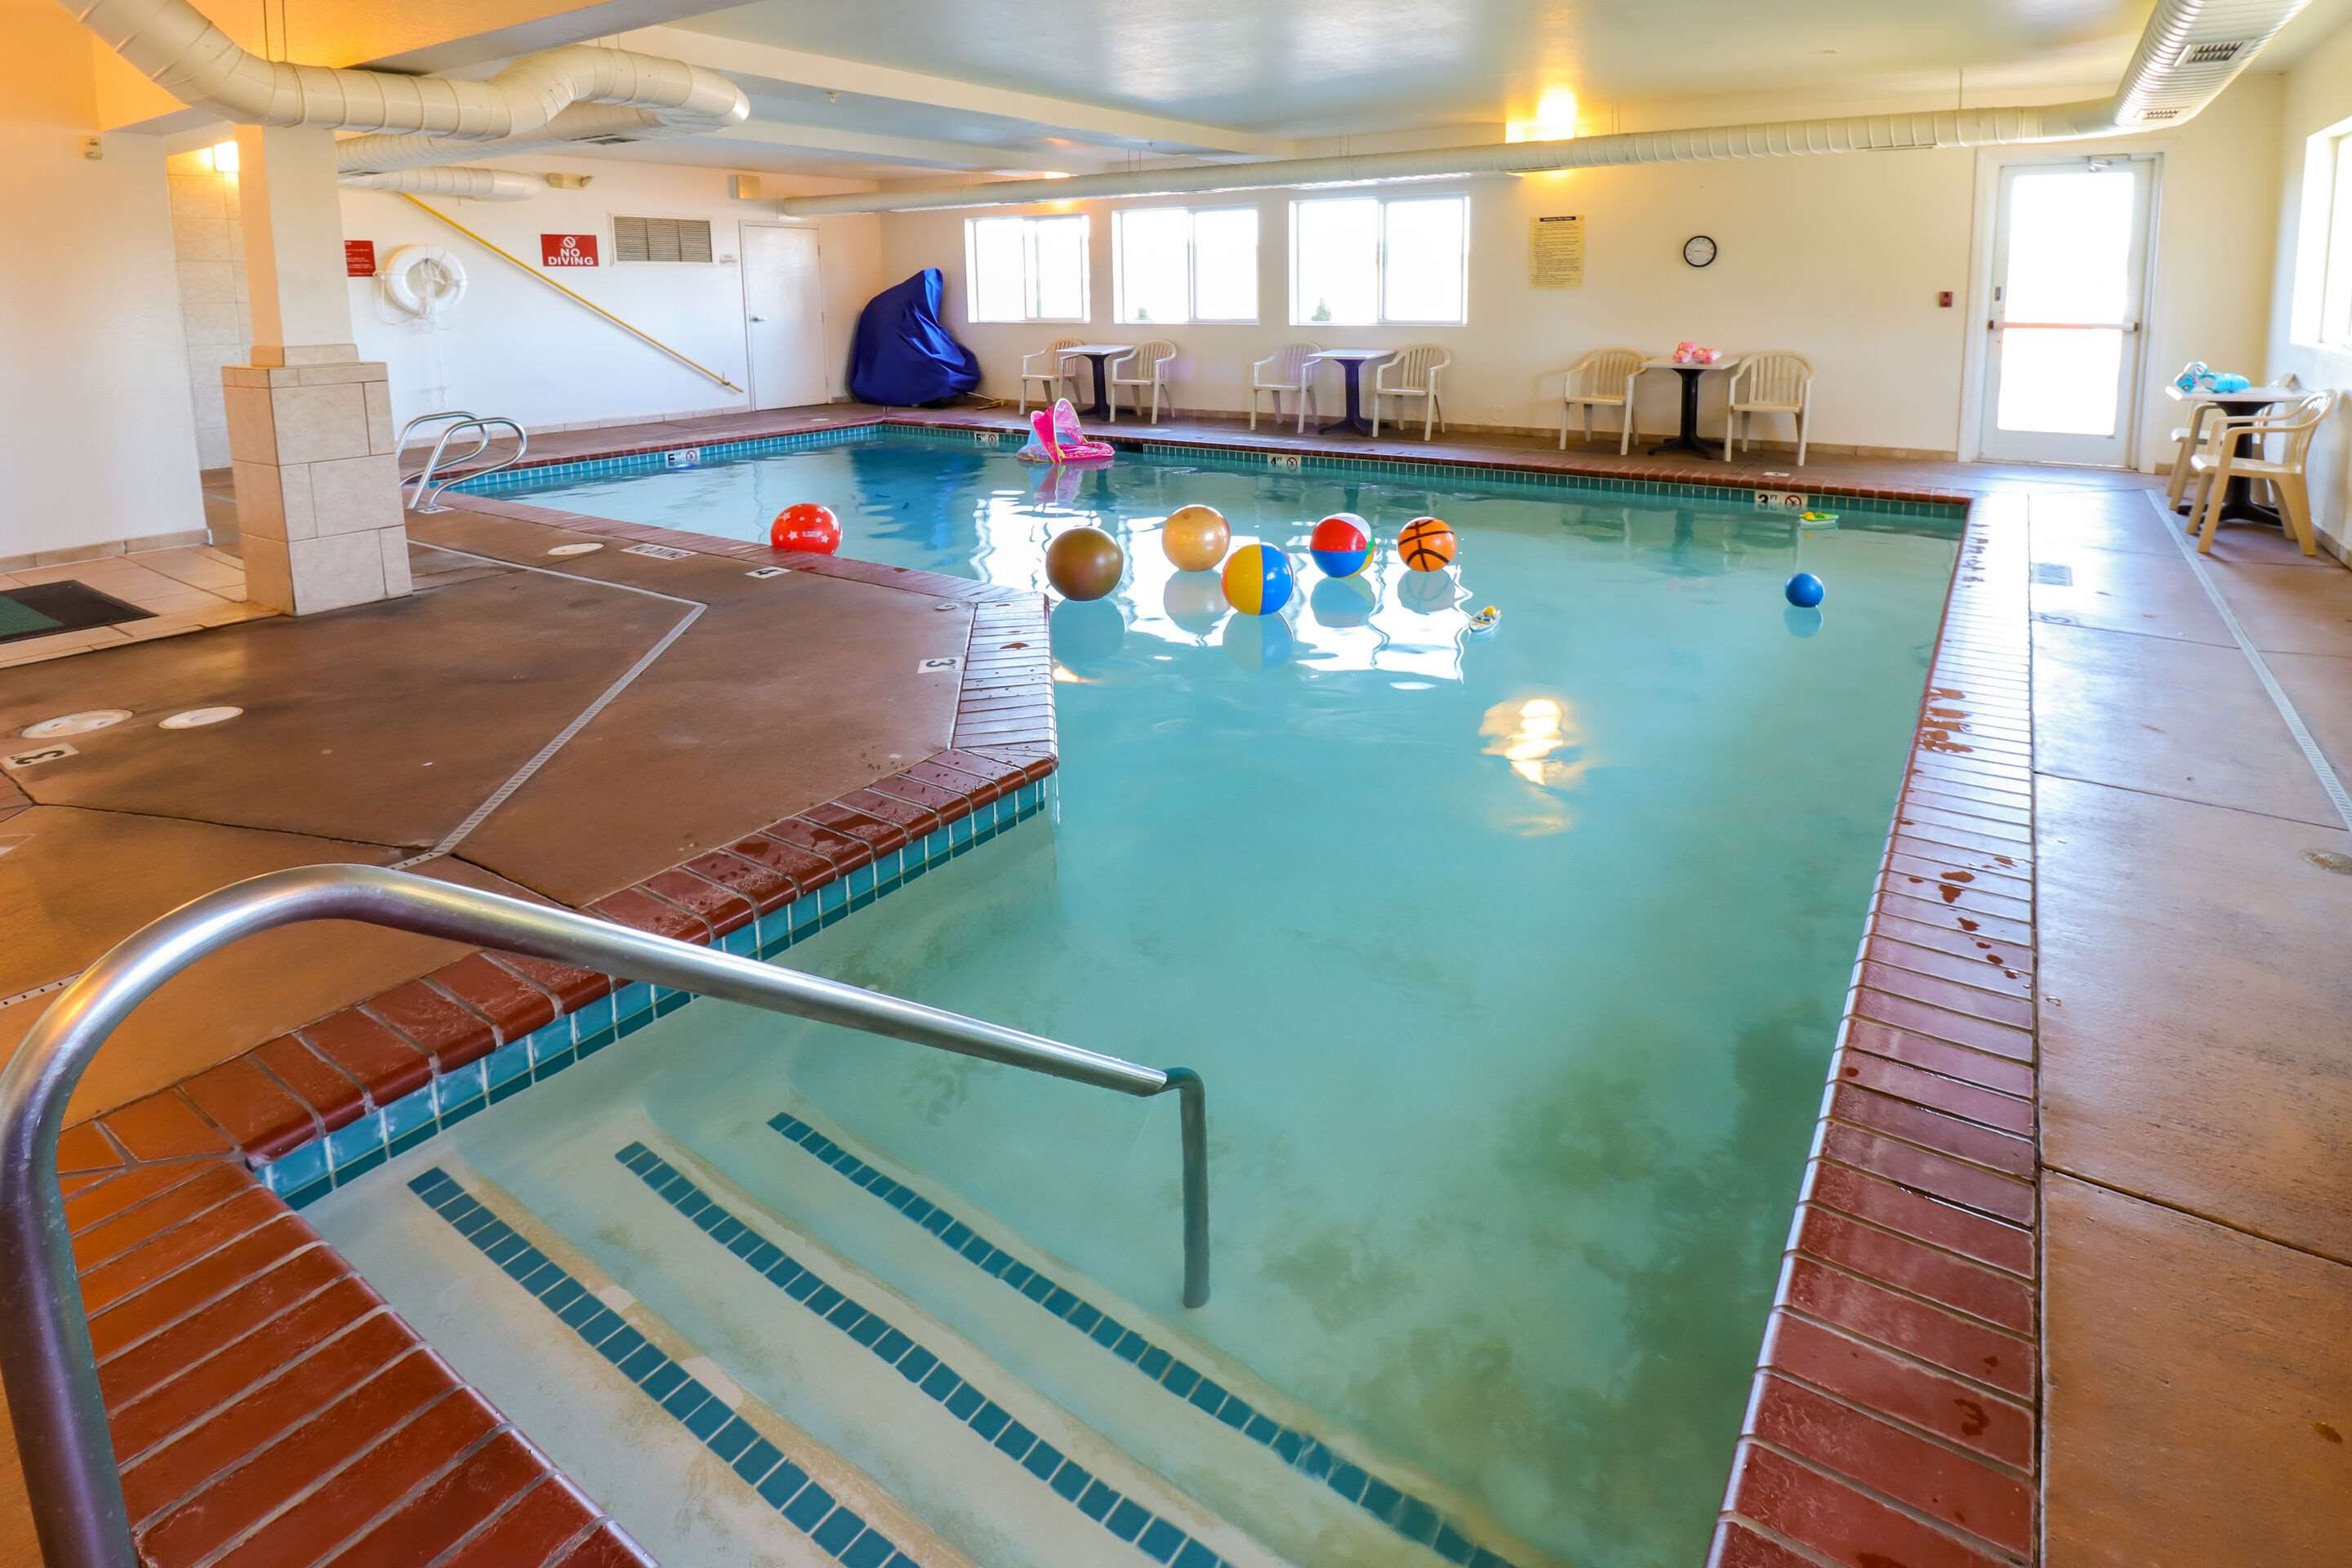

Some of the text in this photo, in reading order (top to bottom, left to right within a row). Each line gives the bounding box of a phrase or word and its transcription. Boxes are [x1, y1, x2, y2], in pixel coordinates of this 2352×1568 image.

[560, 247, 581, 257] NO
[548, 256, 595, 265] DIVING
[926, 659, 956, 667] 3
[16, 751, 65, 764] 3
